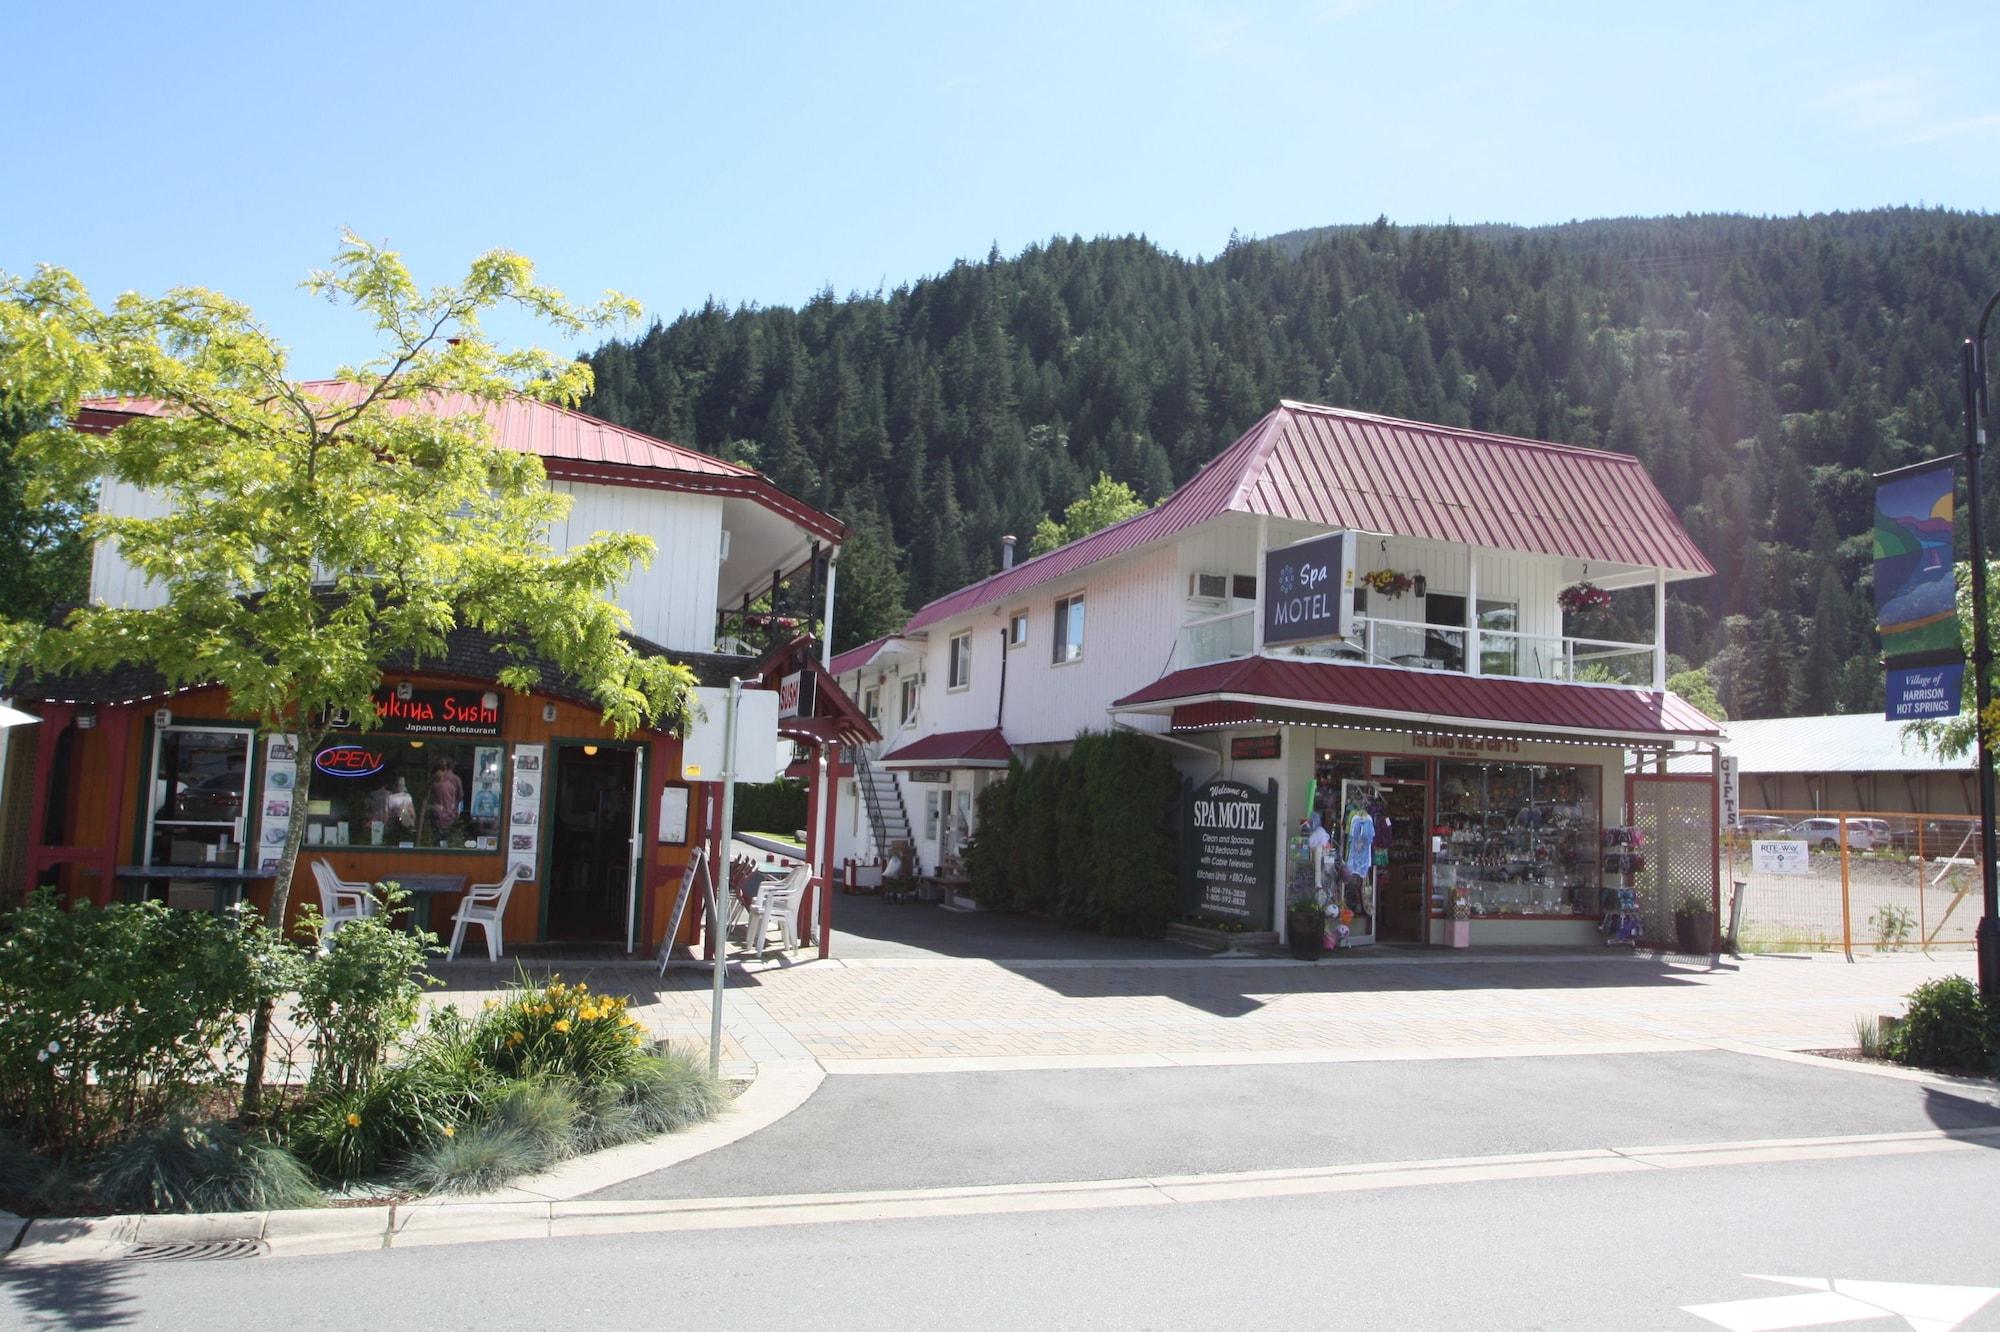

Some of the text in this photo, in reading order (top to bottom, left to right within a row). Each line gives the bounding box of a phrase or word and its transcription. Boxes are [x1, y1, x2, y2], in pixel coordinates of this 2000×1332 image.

[1300, 563, 1328, 590] Spa
[1274, 593, 1331, 625] MOTEL
[1905, 672, 1944, 687] Village of
[780, 680, 799, 710] SUSHI
[1903, 688, 1944, 701] HARRISON
[367, 691, 434, 721] ukiya
[1896, 700, 1949, 714] HOT SPRINGS
[405, 723, 497, 735] Japanese Restaurant
[1412, 735, 1454, 749] ISLAND
[1487, 739, 1519, 753] GIFTS
[318, 751, 383, 769] OPEN
[1209, 784, 1248, 799] Welcome to
[1720, 759, 1736, 825] GIFTS
[1193, 800, 1264, 830] SPA MOTEL
[1202, 833, 1255, 845] Clean and Spacious
[1215, 846, 1239, 855] Bedroom
[1200, 856, 1254, 869] with Cable Television
[1196, 870, 1215, 880] Kitchen
[1215, 871, 1227, 880] Units
[1243, 874, 1257, 885] Area
